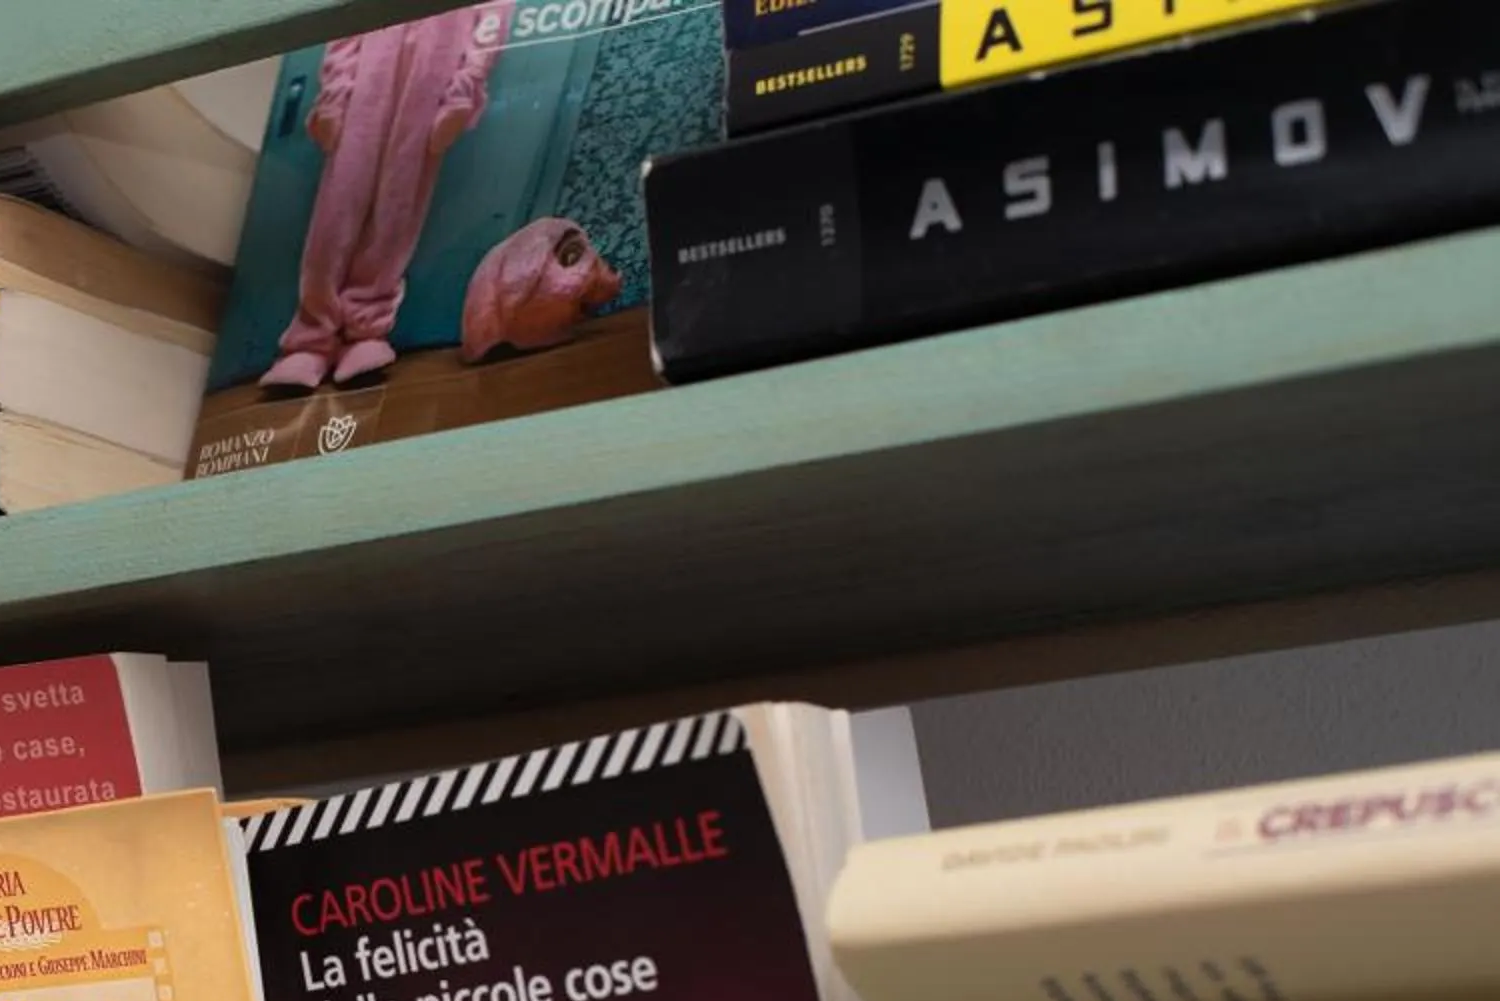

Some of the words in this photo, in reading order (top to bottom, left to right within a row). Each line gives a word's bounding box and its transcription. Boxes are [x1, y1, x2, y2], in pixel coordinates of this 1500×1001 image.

[756, 56, 867, 96] BESTSELLERS
[909, 76, 1430, 241] ASIMOV
[678, 227, 786, 264] BESTSELLERS
[2, 681, 86, 714] svetta
[12, 732, 87, 762] case,
[291, 857, 492, 937] CAROLINE
[497, 810, 728, 896] VERMALLE
[7, 902, 82, 938] POVERE
[301, 949, 346, 992] La
[356, 917, 489, 982] felicità
